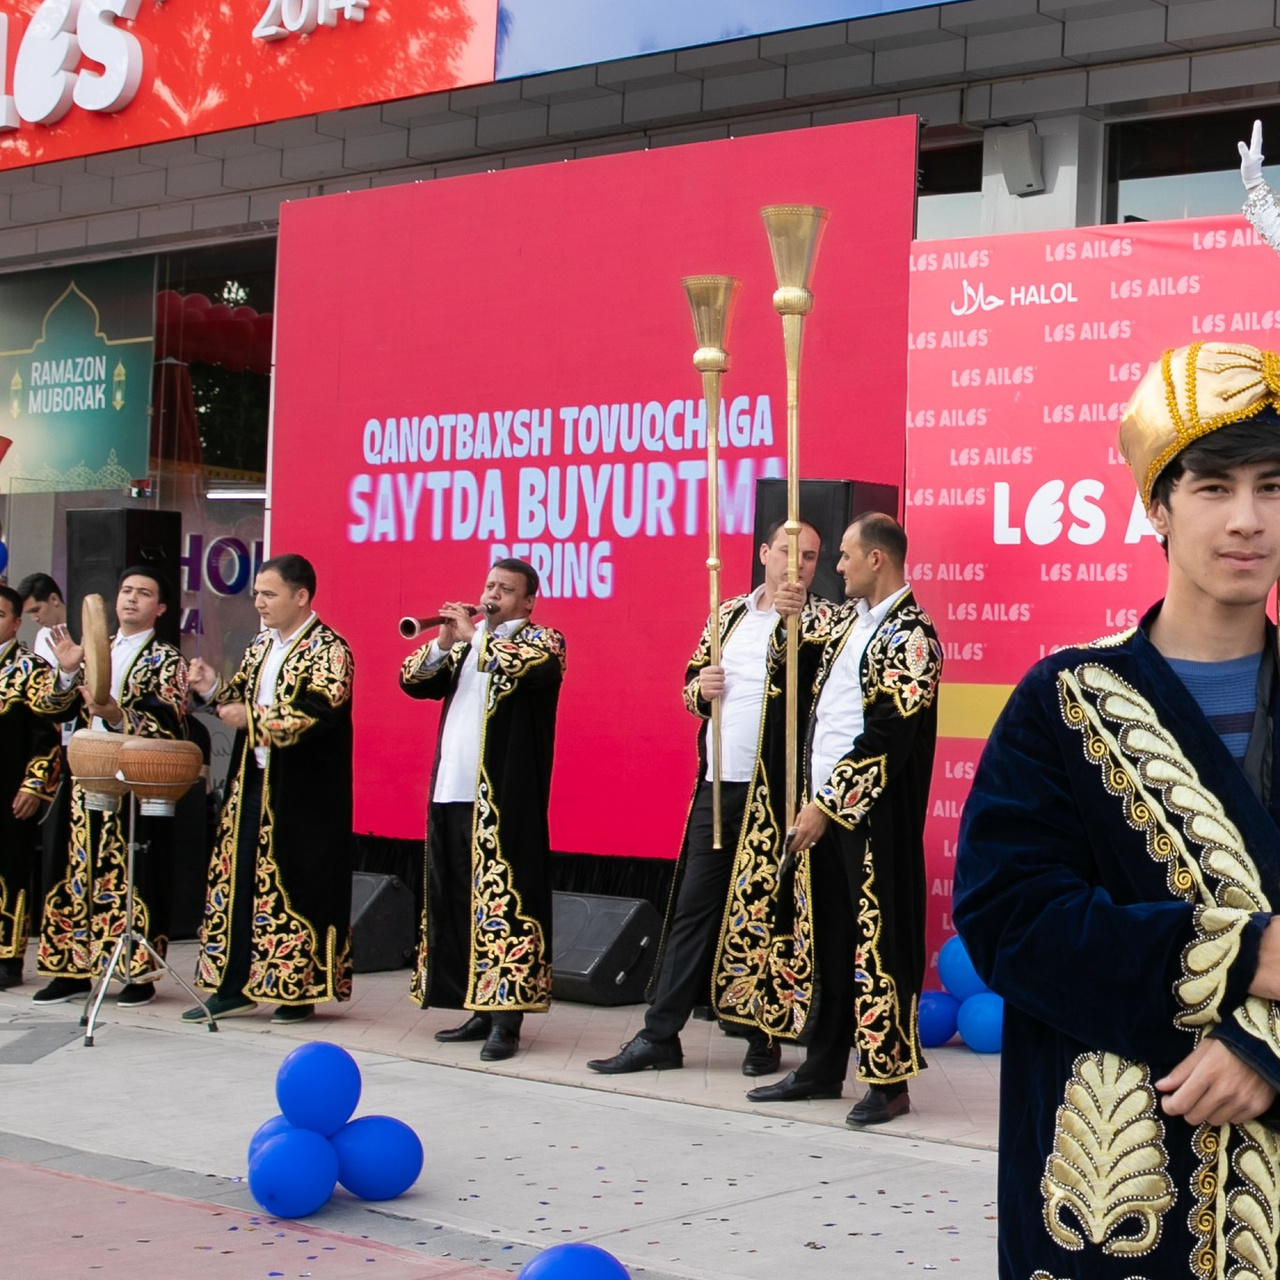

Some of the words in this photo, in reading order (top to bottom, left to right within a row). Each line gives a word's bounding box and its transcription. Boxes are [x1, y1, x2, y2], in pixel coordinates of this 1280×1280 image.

[1232, 229, 1268, 247] AIL
[950, 279, 1004, 316] حلال
[1010, 282, 1078, 306] HALOL
[30, 355, 107, 386] RAMAZON
[28, 384, 107, 414] MUBORAK
[363, 408, 552, 464] QANOTBAXSH
[348, 469, 502, 543] SAYTDA
